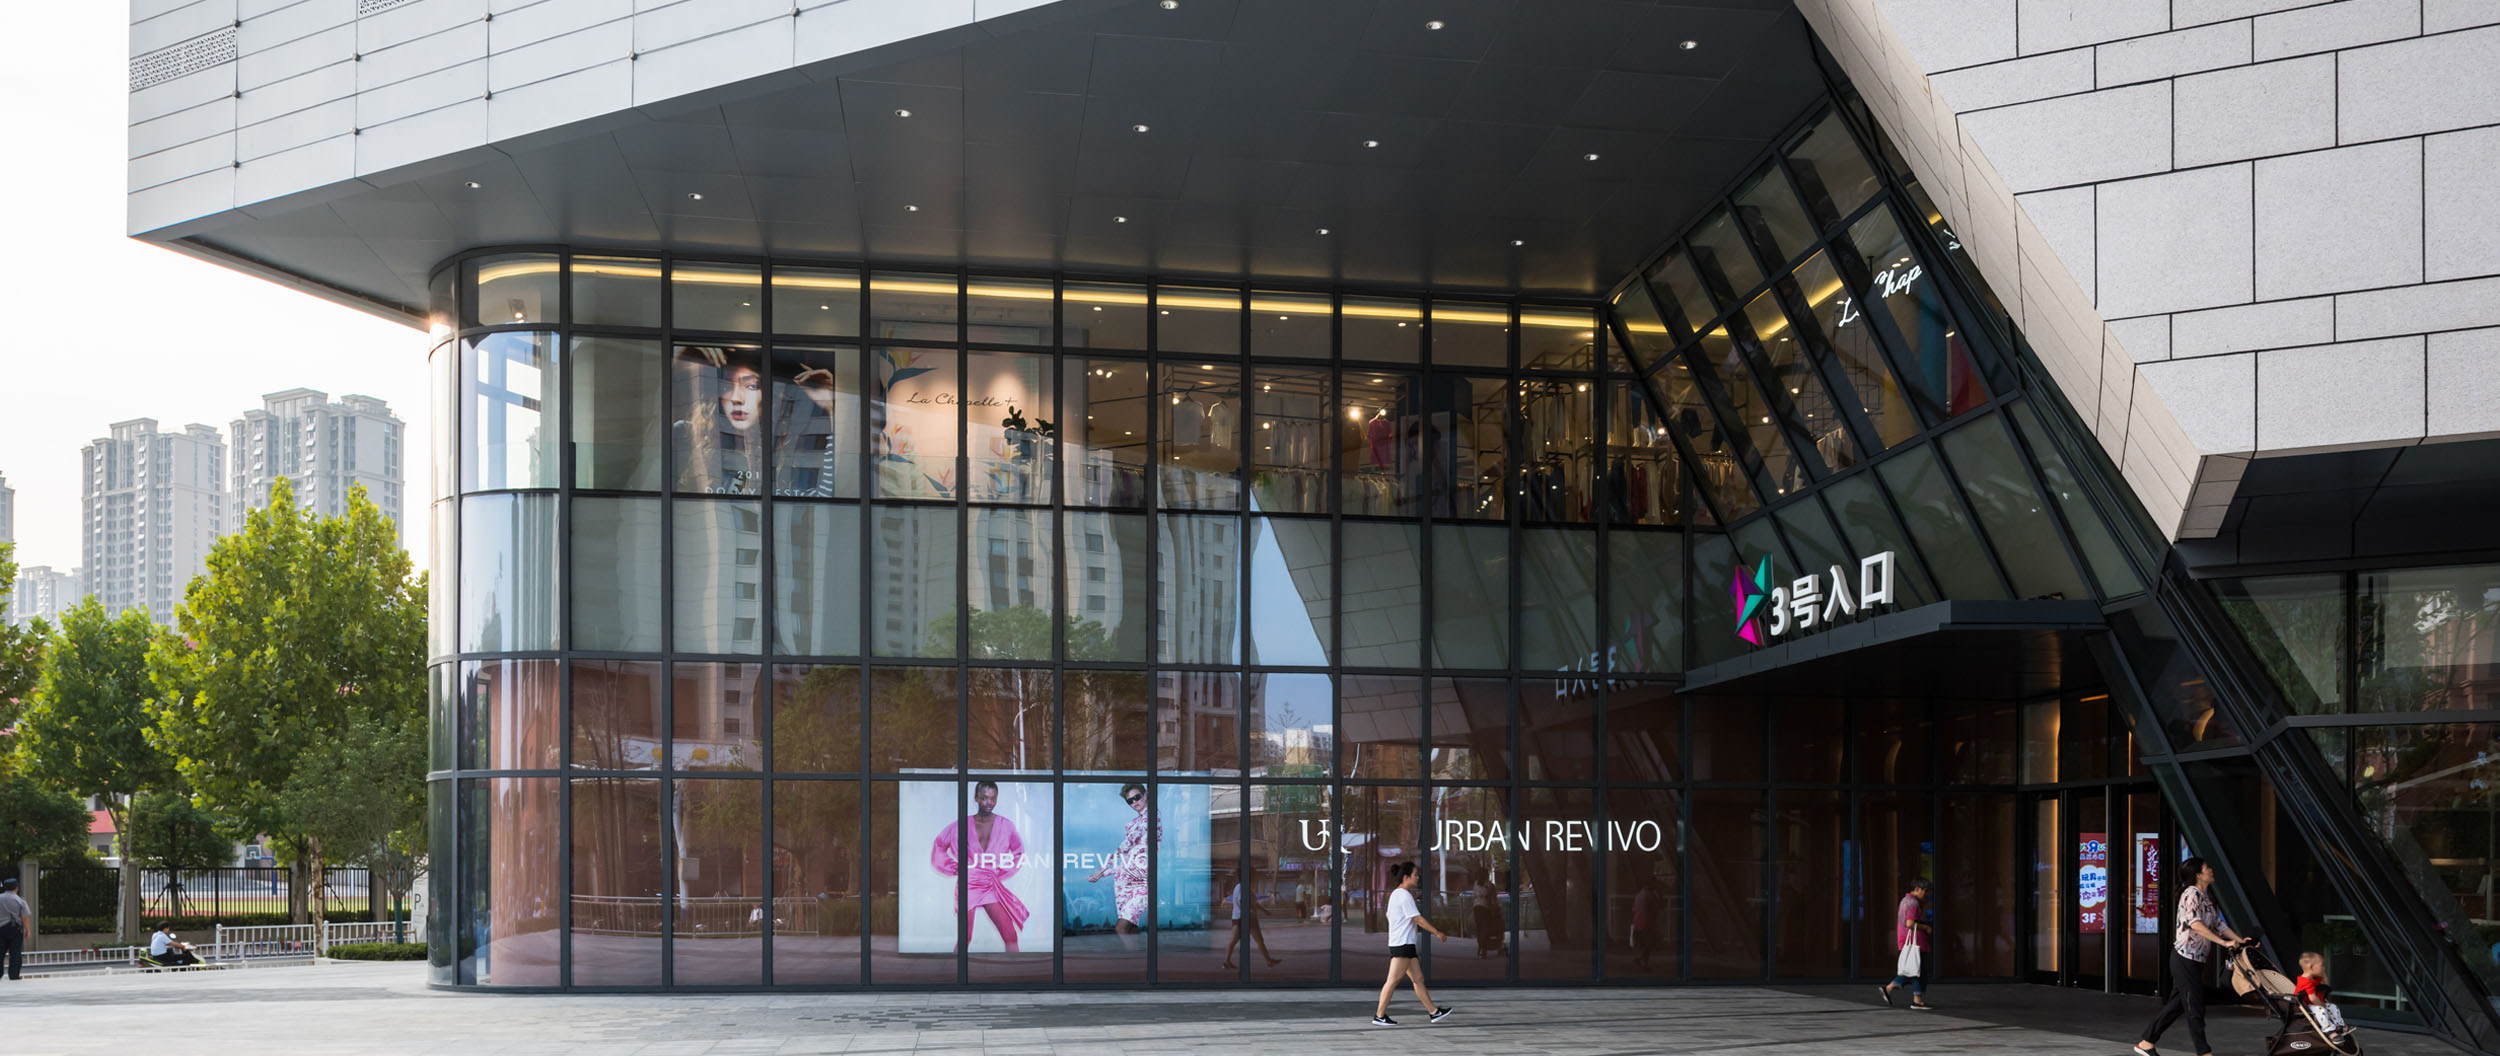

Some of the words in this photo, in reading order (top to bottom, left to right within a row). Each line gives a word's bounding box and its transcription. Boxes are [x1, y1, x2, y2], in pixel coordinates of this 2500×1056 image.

[906, 392, 930, 404] La
[736, 470, 760, 479] 201
[1769, 550, 1895, 636] 3号入口
[1063, 852, 1148, 869] REVIVO
[2081, 912, 2097, 924] 3F
